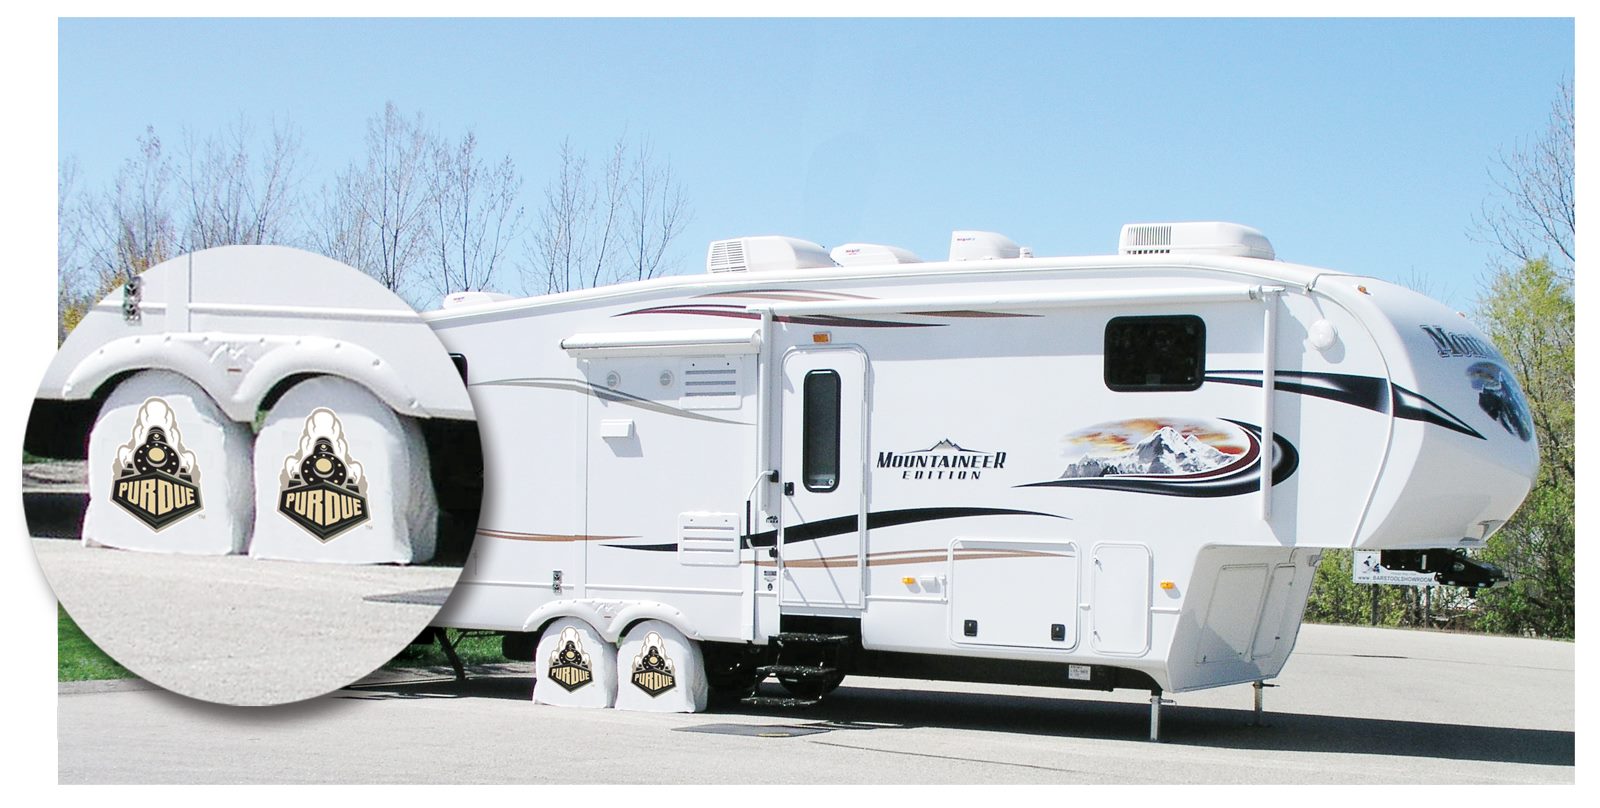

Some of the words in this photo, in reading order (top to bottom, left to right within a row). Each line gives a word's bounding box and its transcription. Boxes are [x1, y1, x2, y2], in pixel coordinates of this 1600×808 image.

[877, 451, 1007, 469] MOUNTAINEER
[902, 470, 981, 480] EDITION
[118, 478, 196, 516] PURDUE
[285, 489, 363, 527] PURDUE
[551, 666, 590, 686] PURDUE
[634, 671, 674, 692] PURDUE
